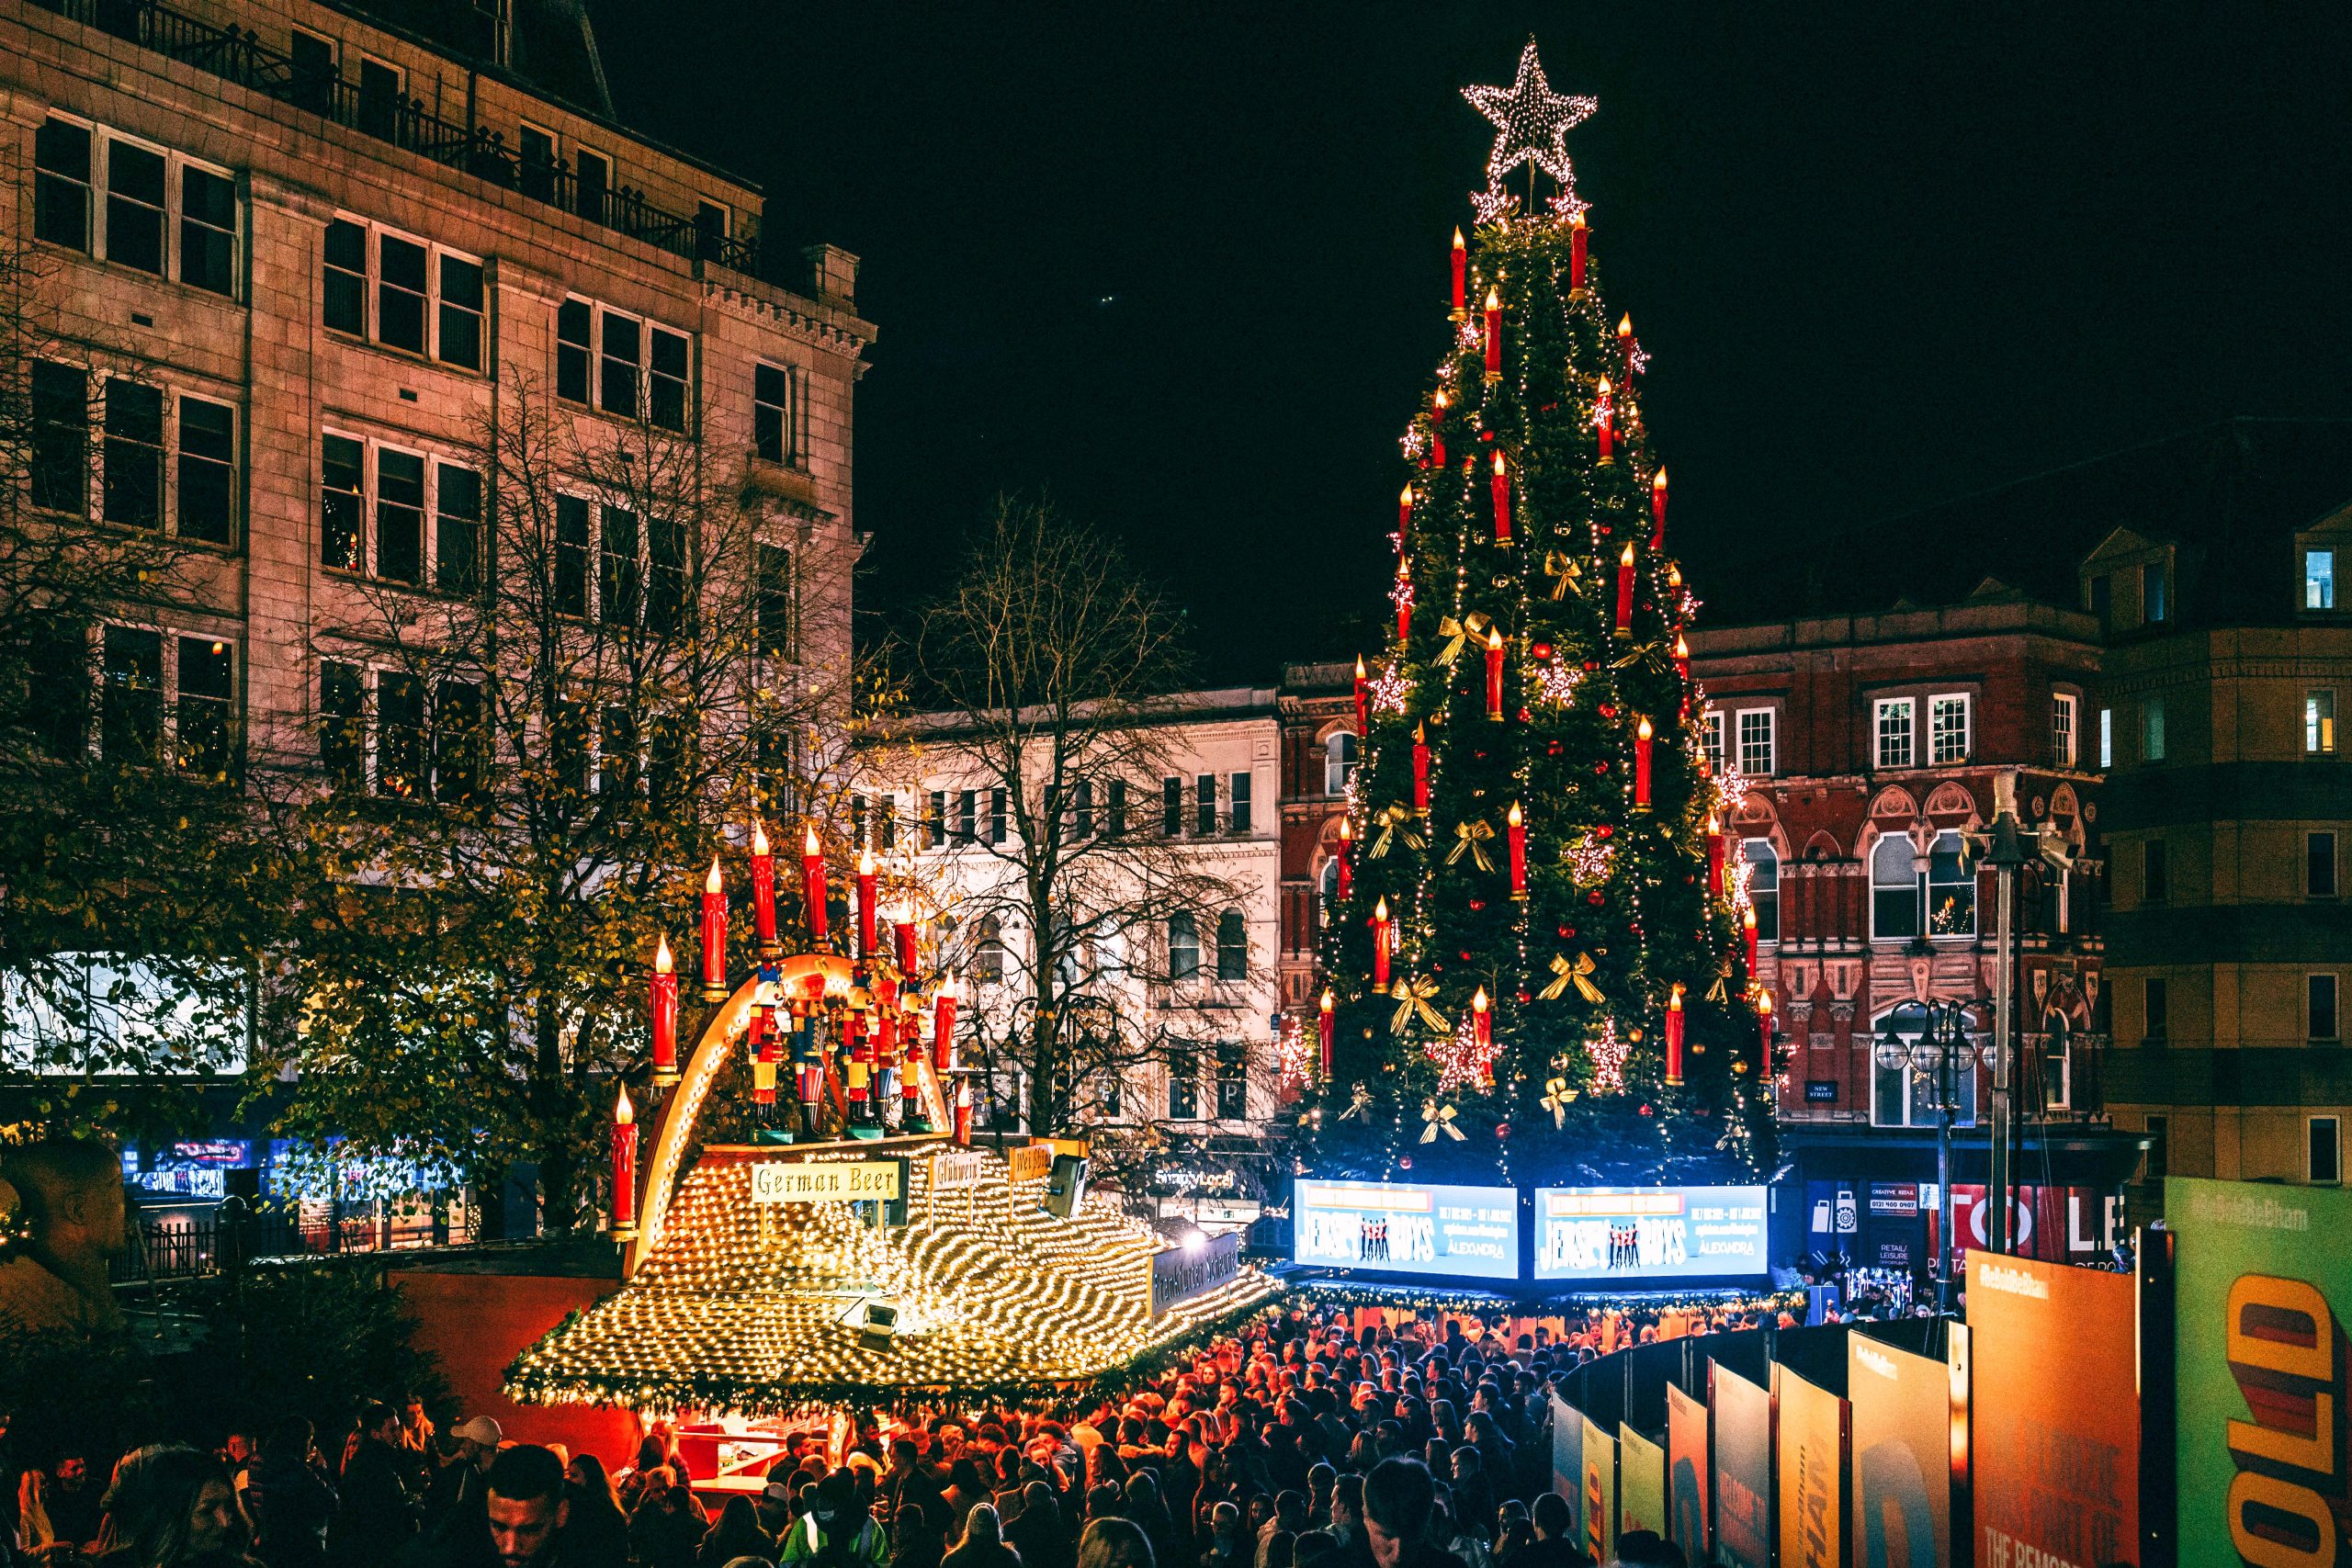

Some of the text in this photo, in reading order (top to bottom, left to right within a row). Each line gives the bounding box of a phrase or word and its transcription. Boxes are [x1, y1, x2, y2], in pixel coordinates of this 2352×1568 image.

[758, 1168, 894, 1195] German Beer
[938, 1156, 977, 1185] Glühwein
[1299, 1210, 1435, 1263] JERSEY BOYS
[1448, 1239, 1505, 1259] ALEXANDRA
[1540, 1217, 1687, 1270] JERSEY BOYS
[1700, 1242, 1755, 1256] ALEXANDRA
[1154, 1250, 1237, 1305] Frankfurter Scheune
